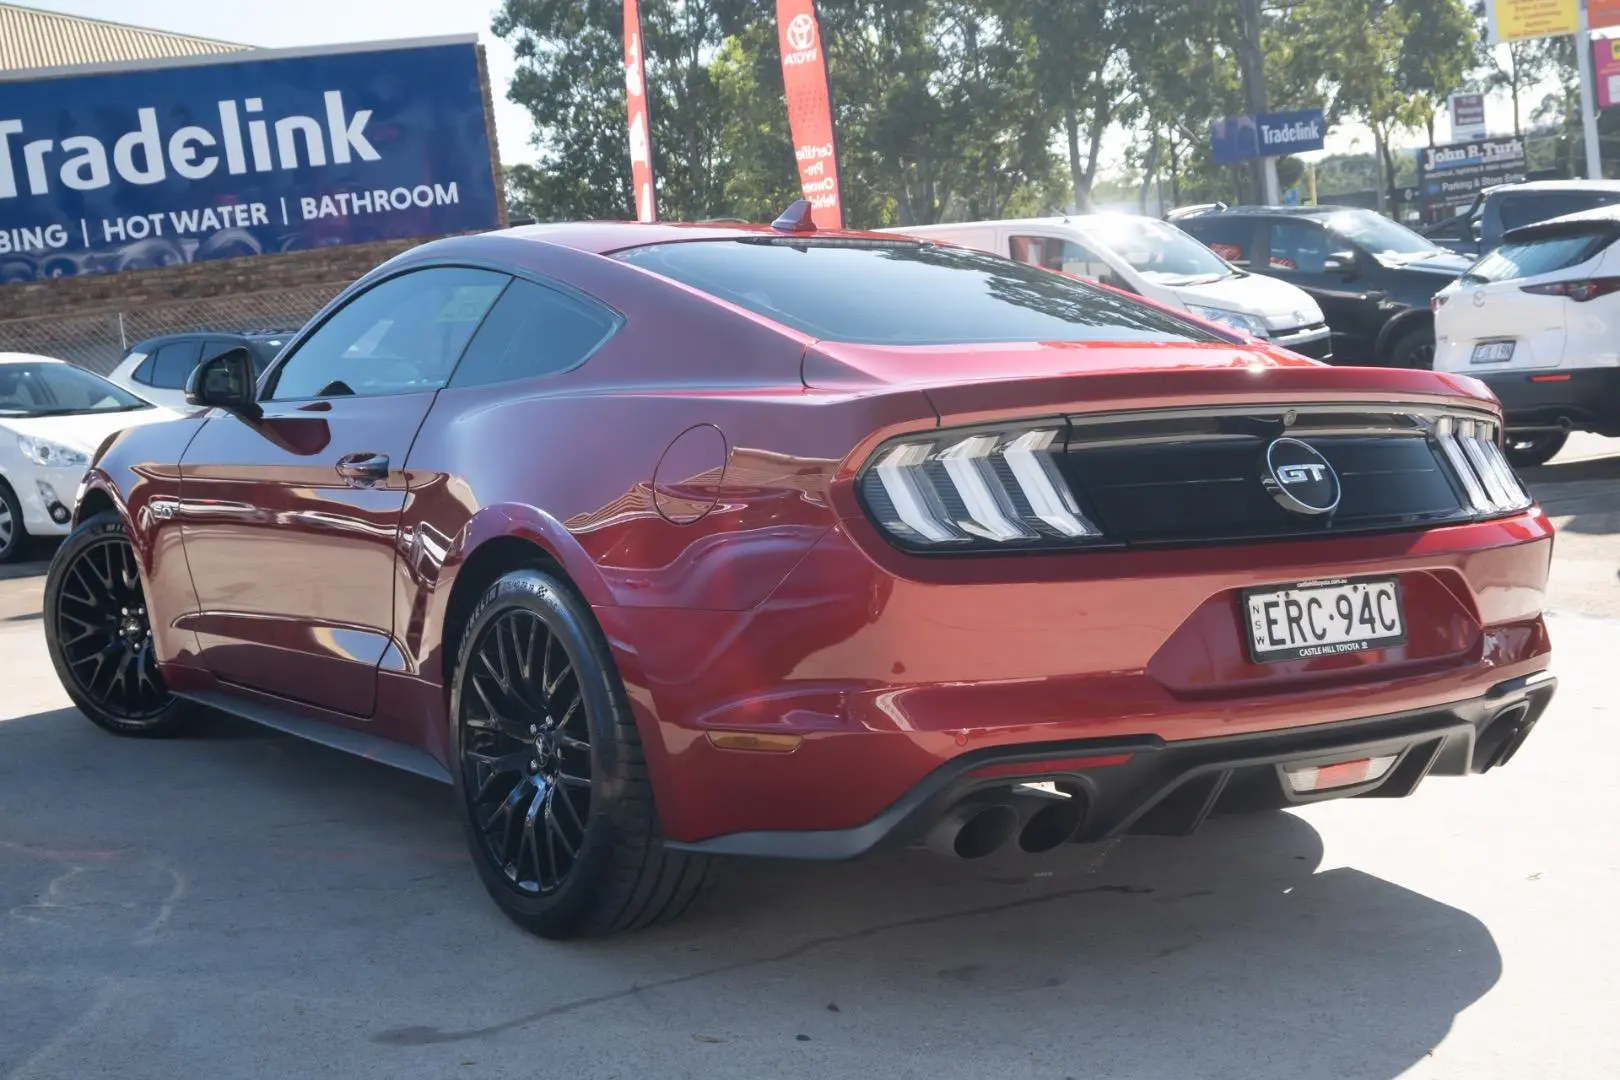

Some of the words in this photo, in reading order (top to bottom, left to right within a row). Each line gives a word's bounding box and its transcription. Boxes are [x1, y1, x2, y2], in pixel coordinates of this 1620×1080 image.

[1261, 120, 1320, 144] Tradelink
[1424, 147, 1466, 170] John
[103, 213, 164, 243] HOT
[169, 202, 269, 234] WATER
[301, 182, 459, 219] BATHROOM
[1277, 464, 1326, 484] GT
[1299, 647, 1322, 657] CASTLE
[1322, 645, 1336, 654] HILL
[1336, 642, 1360, 652] TOYOTA
